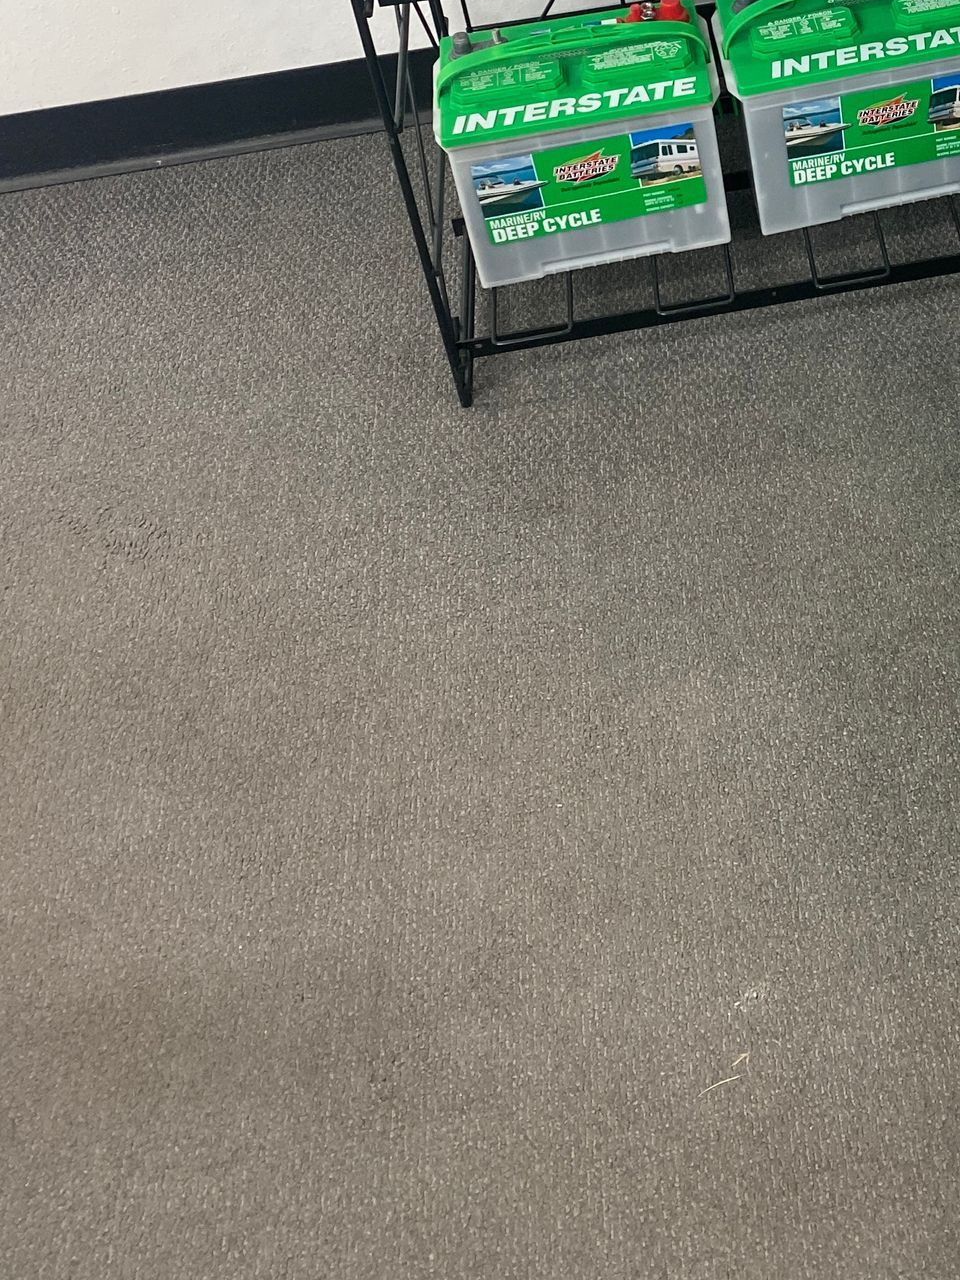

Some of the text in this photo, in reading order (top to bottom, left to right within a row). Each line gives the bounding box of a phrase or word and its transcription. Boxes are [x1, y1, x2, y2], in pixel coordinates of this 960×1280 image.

[452, 76, 697, 135] INTERSTATE
[860, 101, 917, 118] INTERSTATE
[862, 109, 914, 124] BATTERIES
[555, 156, 617, 174] INTERSTATE
[792, 153, 846, 171] MARINE/RV
[793, 151, 896, 186] DEEP CYCLE
[559, 165, 614, 180] BATTERIES
[489, 209, 547, 230] MARINE/RV
[492, 208, 602, 244] DEEP CYCLE
